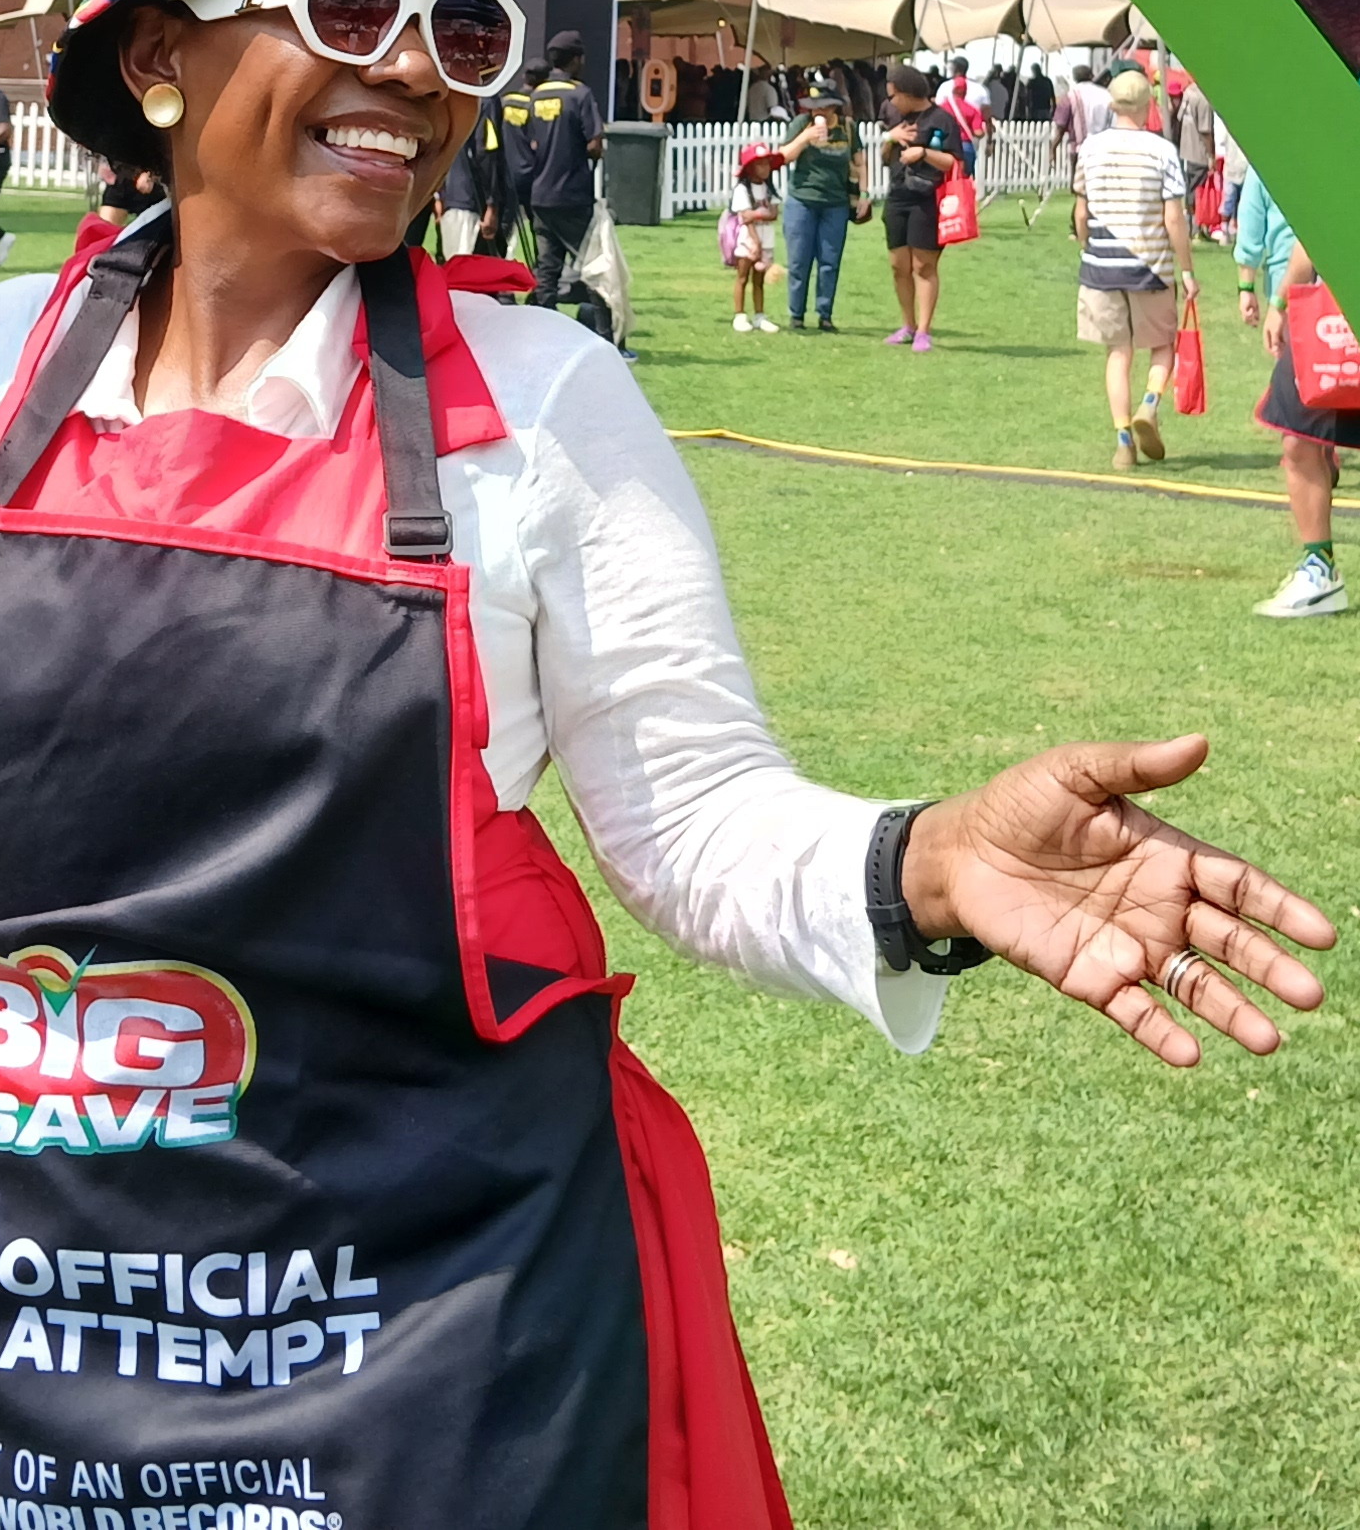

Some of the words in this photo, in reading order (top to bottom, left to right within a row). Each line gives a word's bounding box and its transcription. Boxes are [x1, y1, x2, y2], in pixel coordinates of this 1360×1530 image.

[13, 1449, 58, 1495] OF
[71, 1460, 125, 1500] AN
[140, 1457, 326, 1502] OFFICIAL
